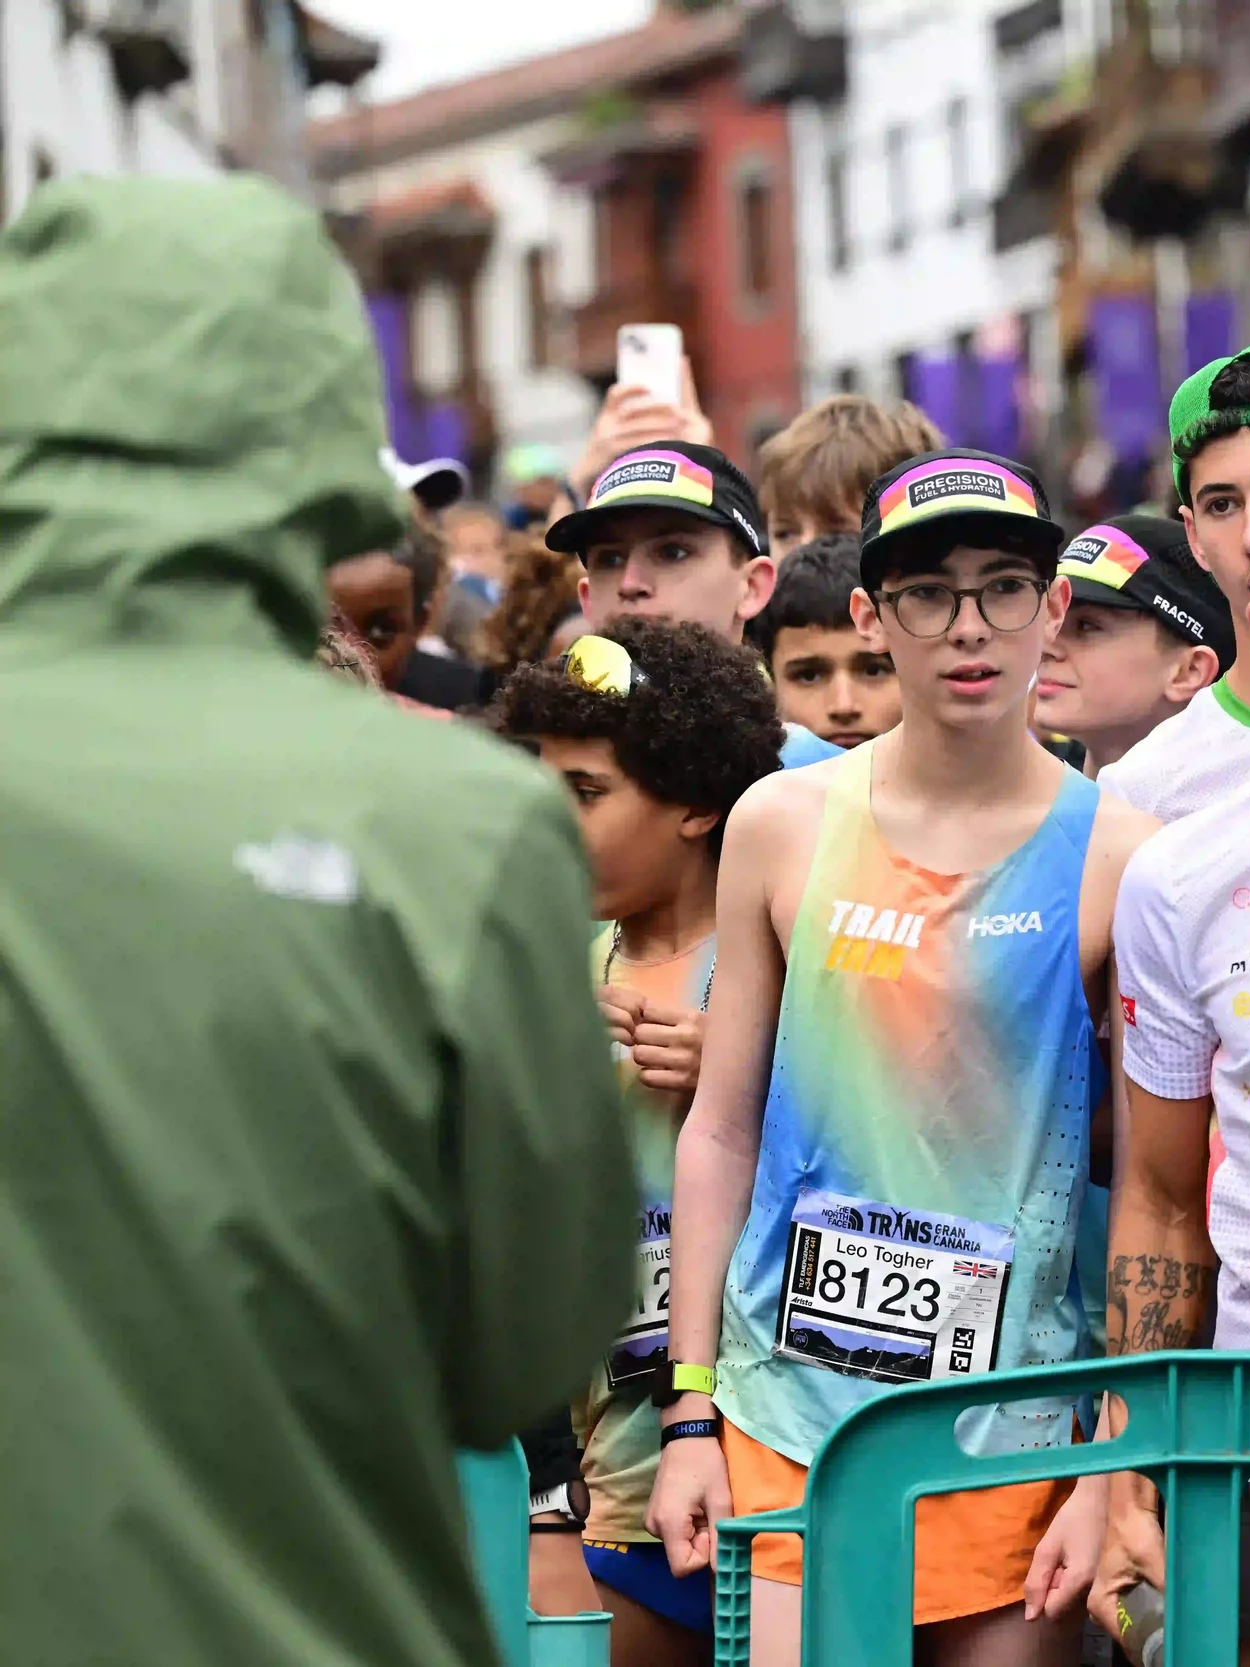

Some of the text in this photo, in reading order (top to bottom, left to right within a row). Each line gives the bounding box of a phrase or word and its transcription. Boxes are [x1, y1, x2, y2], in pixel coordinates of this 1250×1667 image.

[914, 475, 1000, 495] PRECISION
[915, 490, 938, 502] FUEL
[948, 485, 1001, 496] HYDRATION
[1153, 594, 1204, 640] FRACTEL
[828, 900, 925, 948] TRAIL
[967, 911, 1043, 938] HOKA
[825, 936, 907, 981] FAM
[821, 1209, 849, 1221] NORTH
[836, 1204, 850, 1214] THE
[637, 1207, 671, 1238] RAN
[827, 1218, 848, 1229] FACE
[867, 1207, 933, 1244] TRANS
[935, 1223, 966, 1239] GRAN
[639, 1247, 671, 1263] arius
[800, 1235, 810, 1276] EMERGENCIAS
[836, 1237, 934, 1270] Leo Togher
[933, 1235, 981, 1253] CANARIA
[819, 1259, 940, 1322] 8123
[674, 1422, 711, 1436] SHORT
